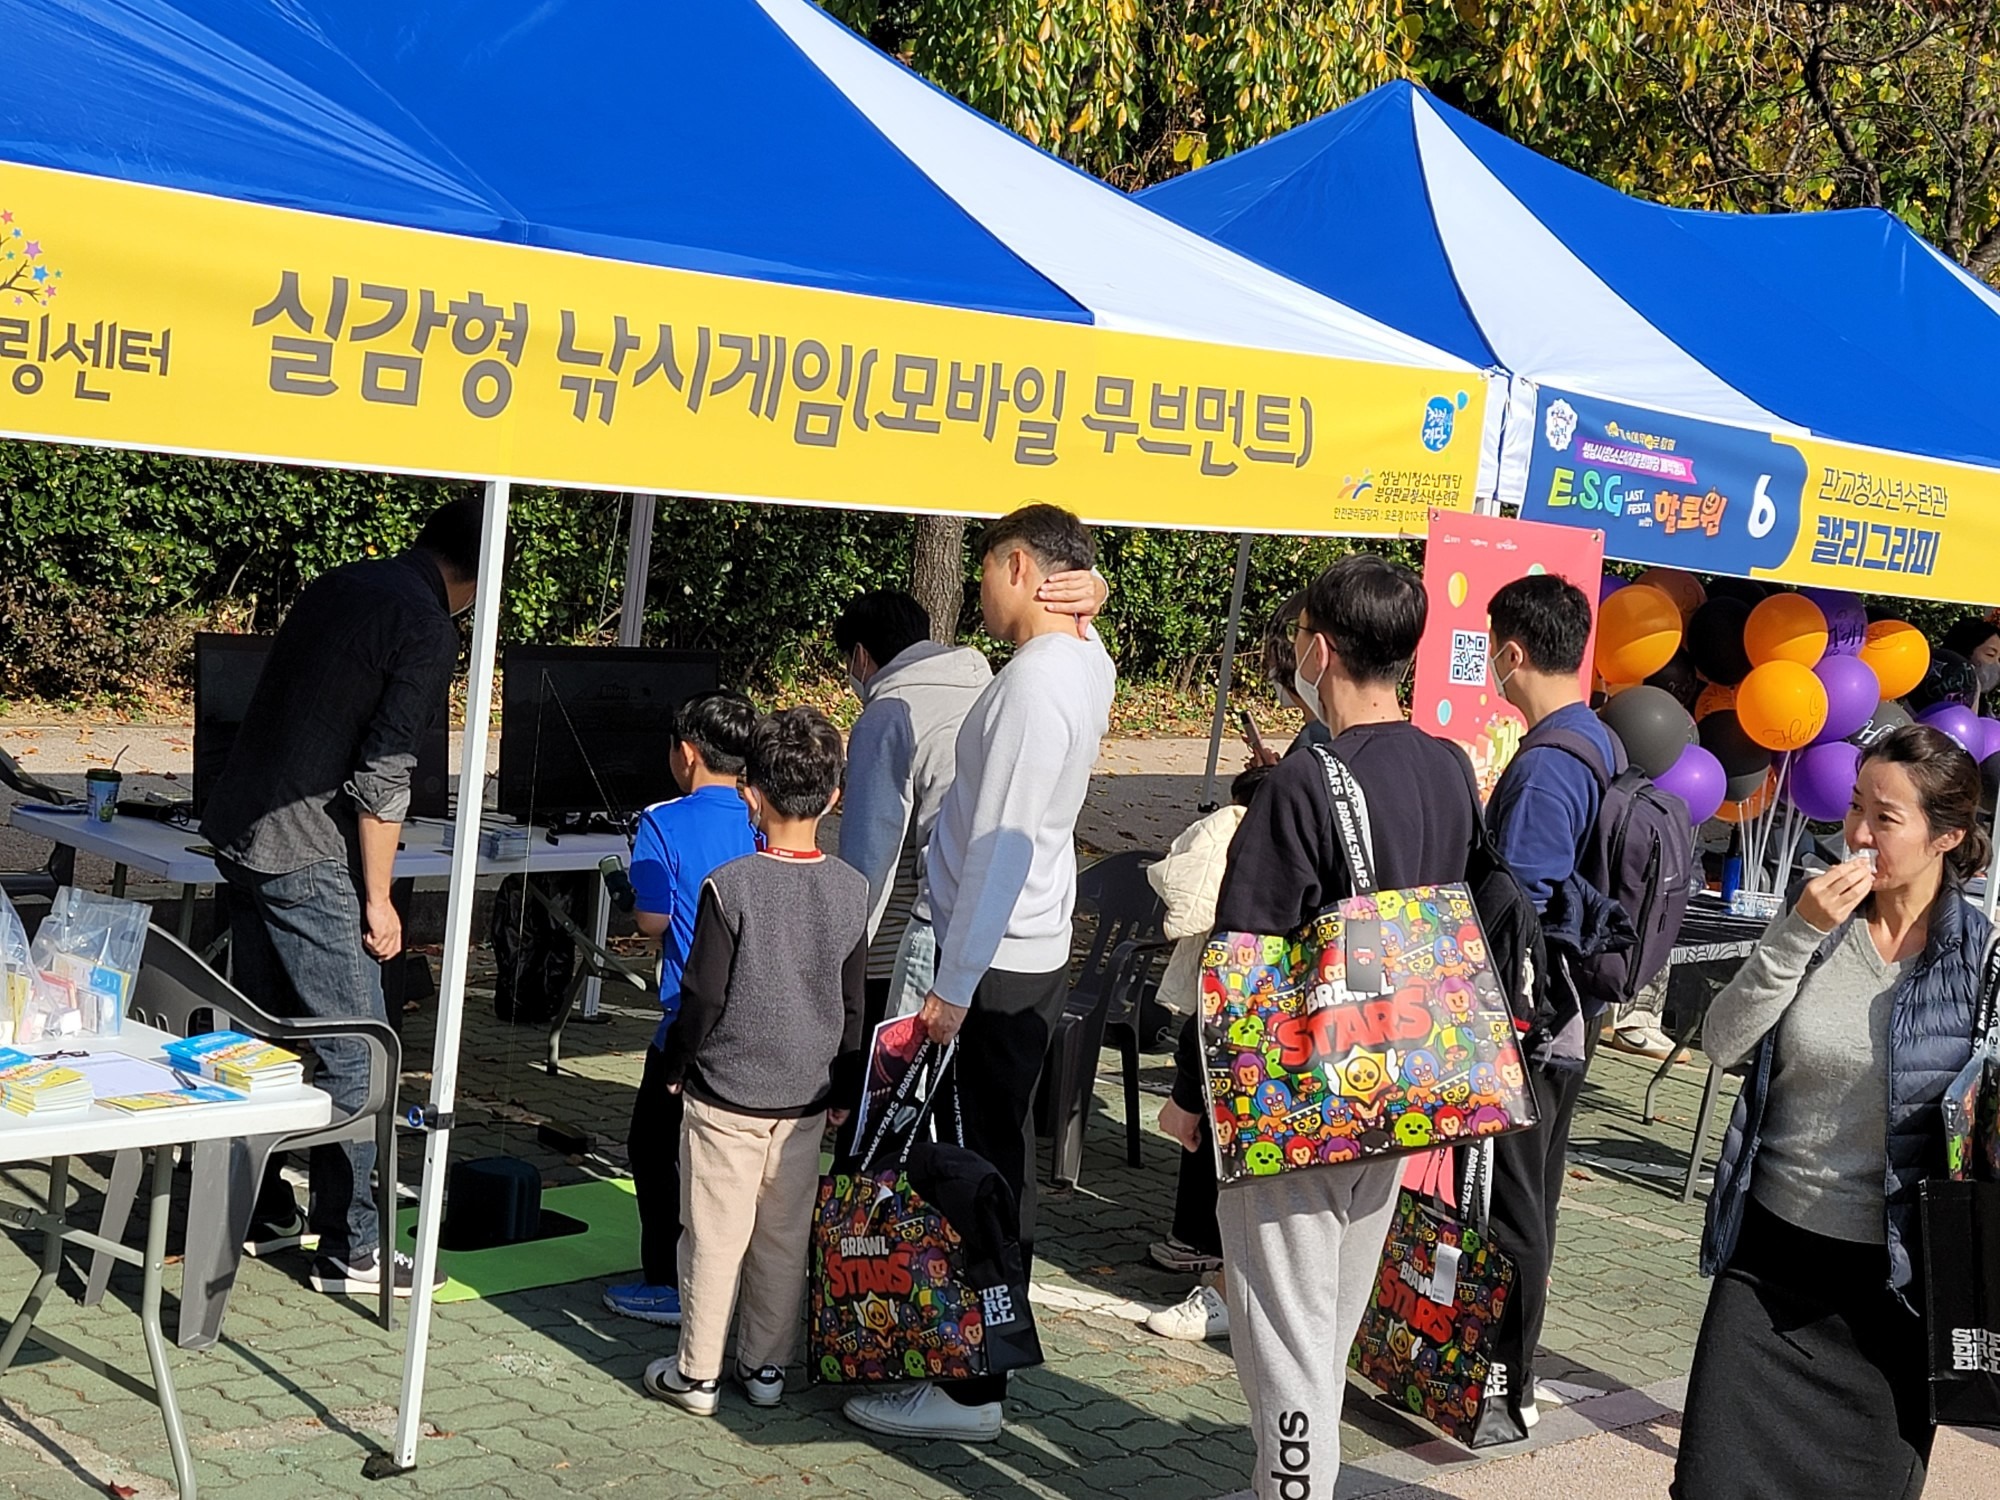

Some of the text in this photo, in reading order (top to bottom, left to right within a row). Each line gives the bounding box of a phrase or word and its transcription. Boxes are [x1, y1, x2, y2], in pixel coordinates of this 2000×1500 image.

[0, 312, 171, 403] 링센터
[252, 270, 1314, 477] 실감형 낚시게임(모바일 무브먼트)
[1379, 470, 1463, 490] 성남시청소년재단
[1624, 489, 1646, 502] LAST
[1818, 467, 1949, 518] 판교청소년수련관
[1626, 502, 1652, 516] FESTA
[1653, 487, 1729, 537] 할로윈
[1747, 473, 1777, 539] 6
[1810, 514, 1941, 576] 캘리그라피
[1335, 800, 1371, 889] BRAWLSTARS
[1306, 972, 1395, 1017] BRAL
[1276, 982, 1434, 1068] STARS
[840, 1234, 890, 1258] BRAWL
[827, 1251, 913, 1298] STARS
[1399, 1260, 1433, 1297] BRAW
[1377, 1266, 1459, 1344] STARS
